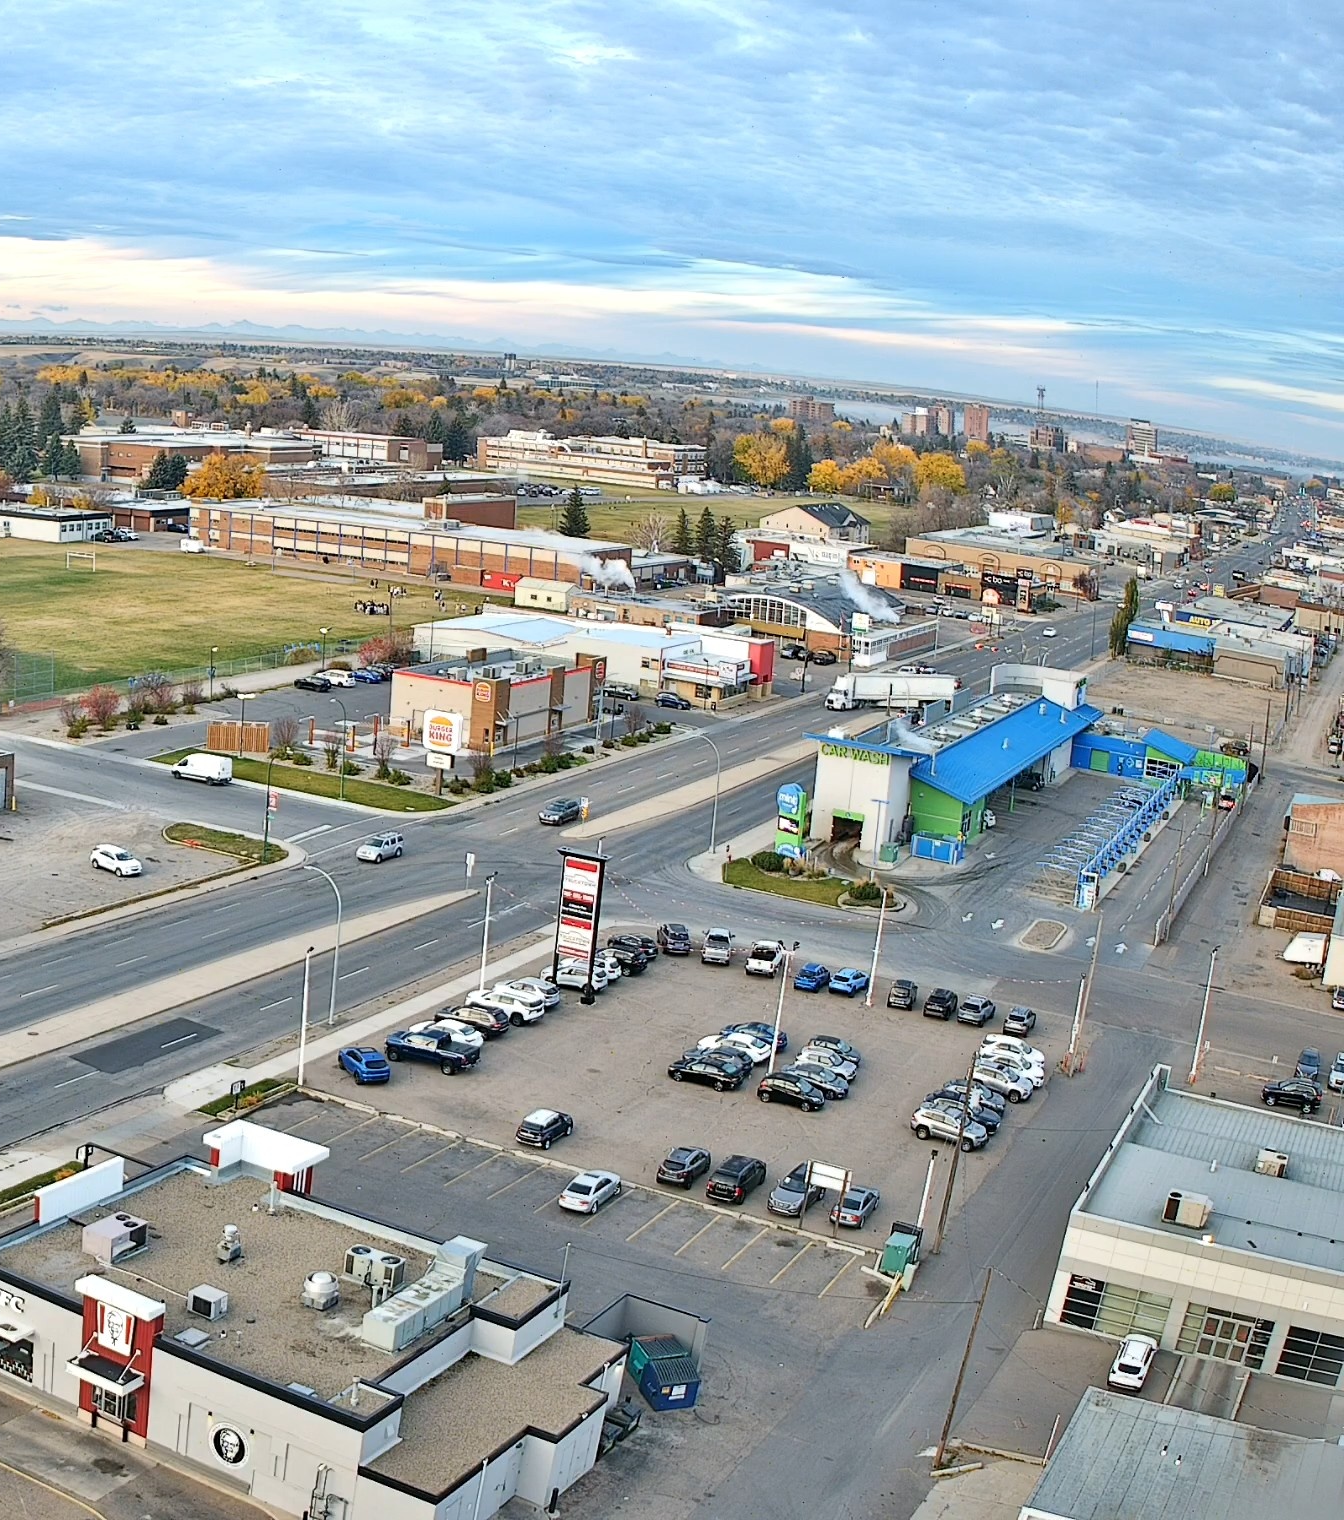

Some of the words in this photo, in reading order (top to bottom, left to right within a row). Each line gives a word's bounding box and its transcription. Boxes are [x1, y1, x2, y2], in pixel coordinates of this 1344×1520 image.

[1189, 615, 1211, 626] AUTO
[428, 725, 453, 733] BURGER
[428, 731, 453, 742] KING
[821, 743, 848, 758] CAR
[849, 748, 890, 766] WASH
